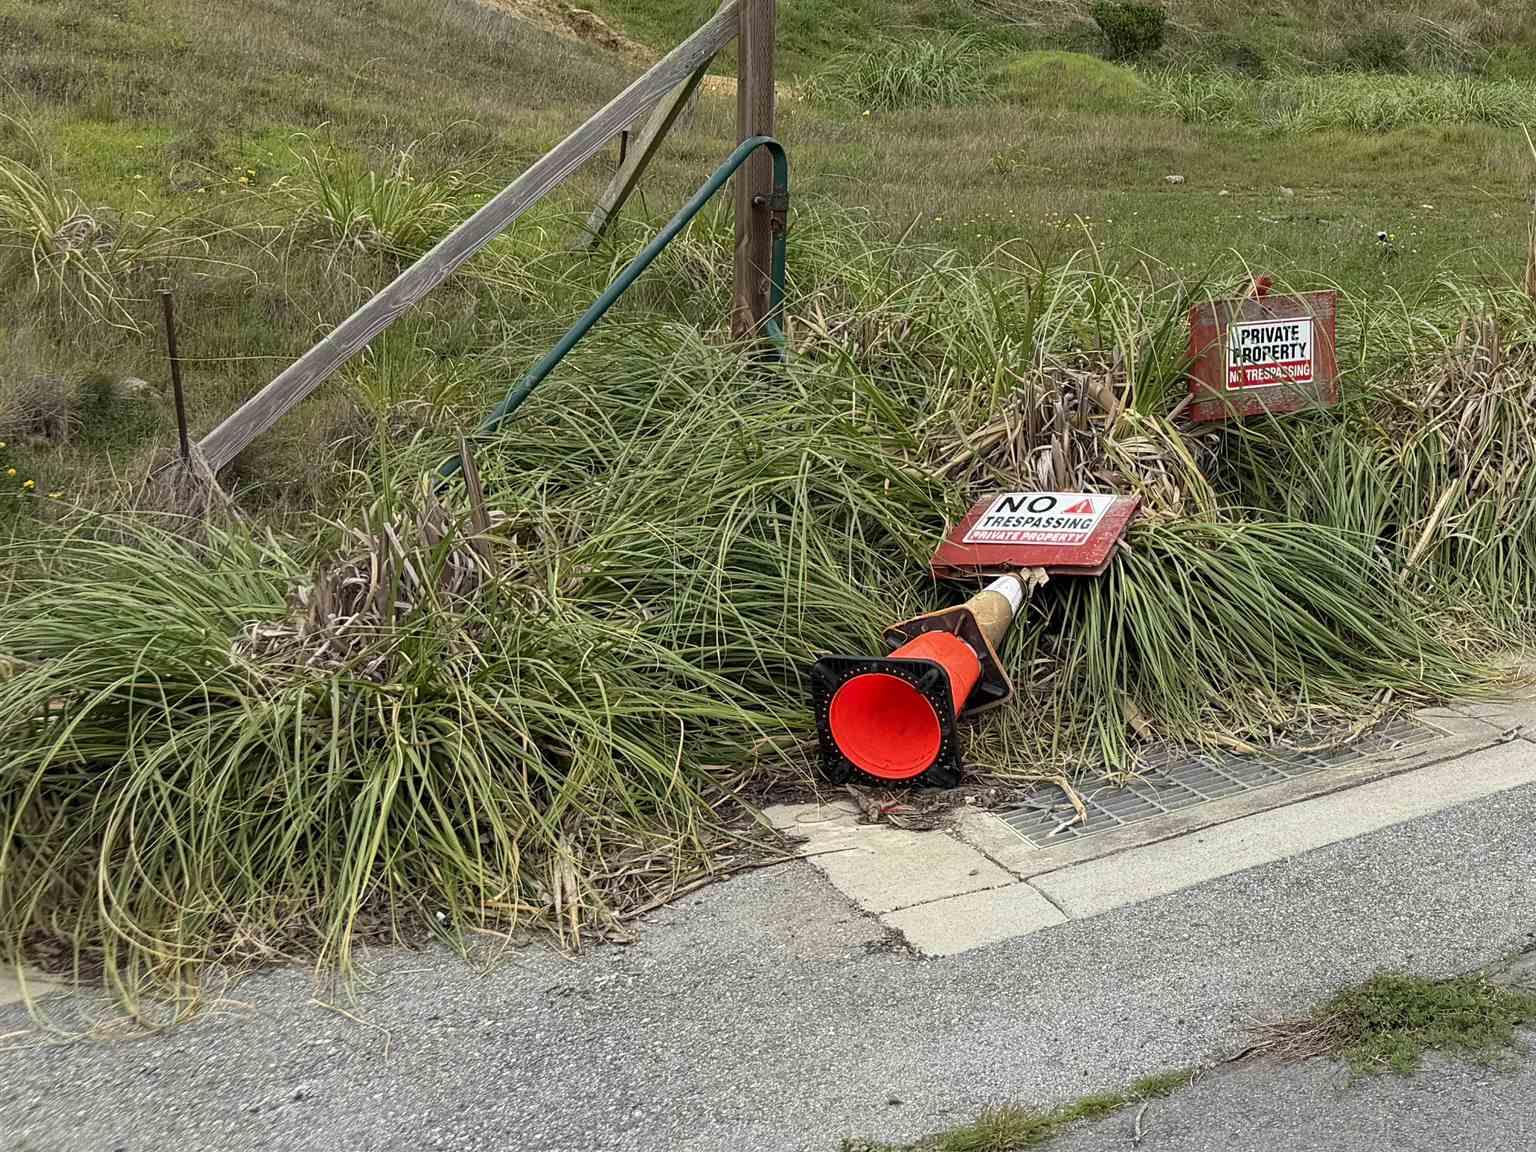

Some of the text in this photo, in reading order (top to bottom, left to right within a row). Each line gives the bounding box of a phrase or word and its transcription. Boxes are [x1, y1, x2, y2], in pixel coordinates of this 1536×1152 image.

[1241, 325, 1299, 345] PRIVATE
[1232, 342, 1306, 364] PROPERTY
[996, 496, 1058, 513] NO
[982, 515, 1093, 530] TRESPASSING
[971, 531, 1086, 542] PRIVATE PROPERTY
